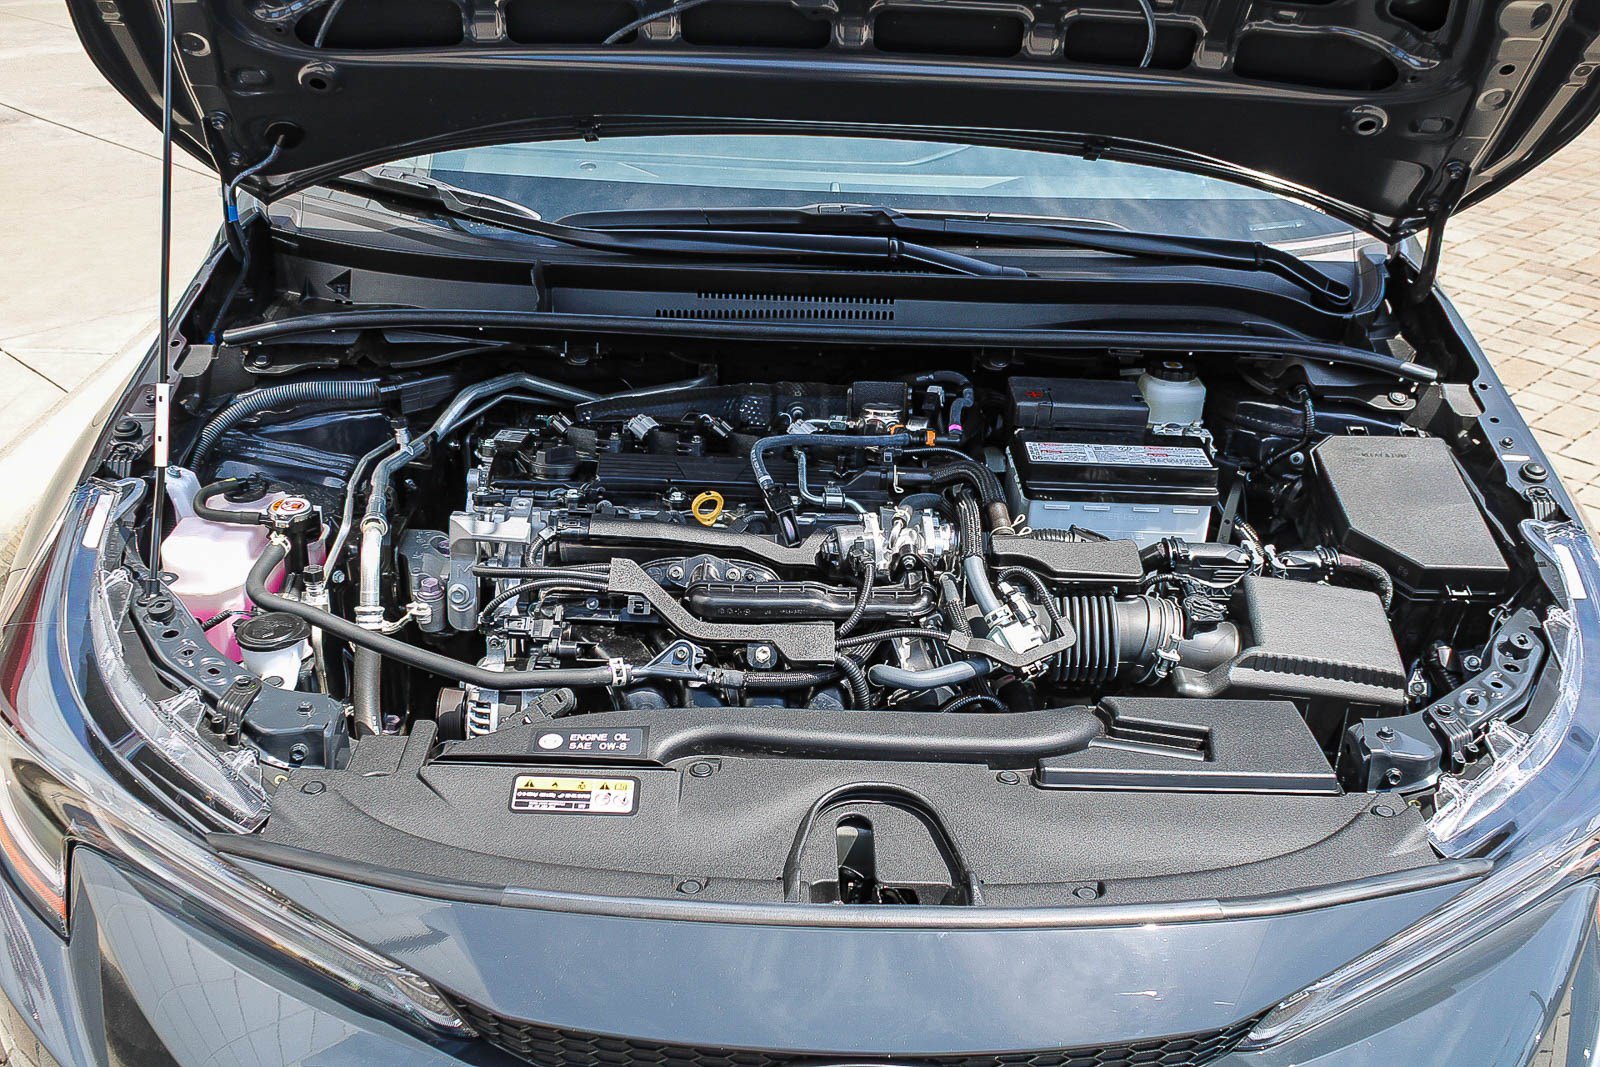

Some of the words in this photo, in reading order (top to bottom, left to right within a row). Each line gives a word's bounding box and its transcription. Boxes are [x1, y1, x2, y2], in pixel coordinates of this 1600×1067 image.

[569, 733, 609, 742] ENGINE
[613, 733, 631, 741] OIL
[568, 742, 592, 750] SAE
